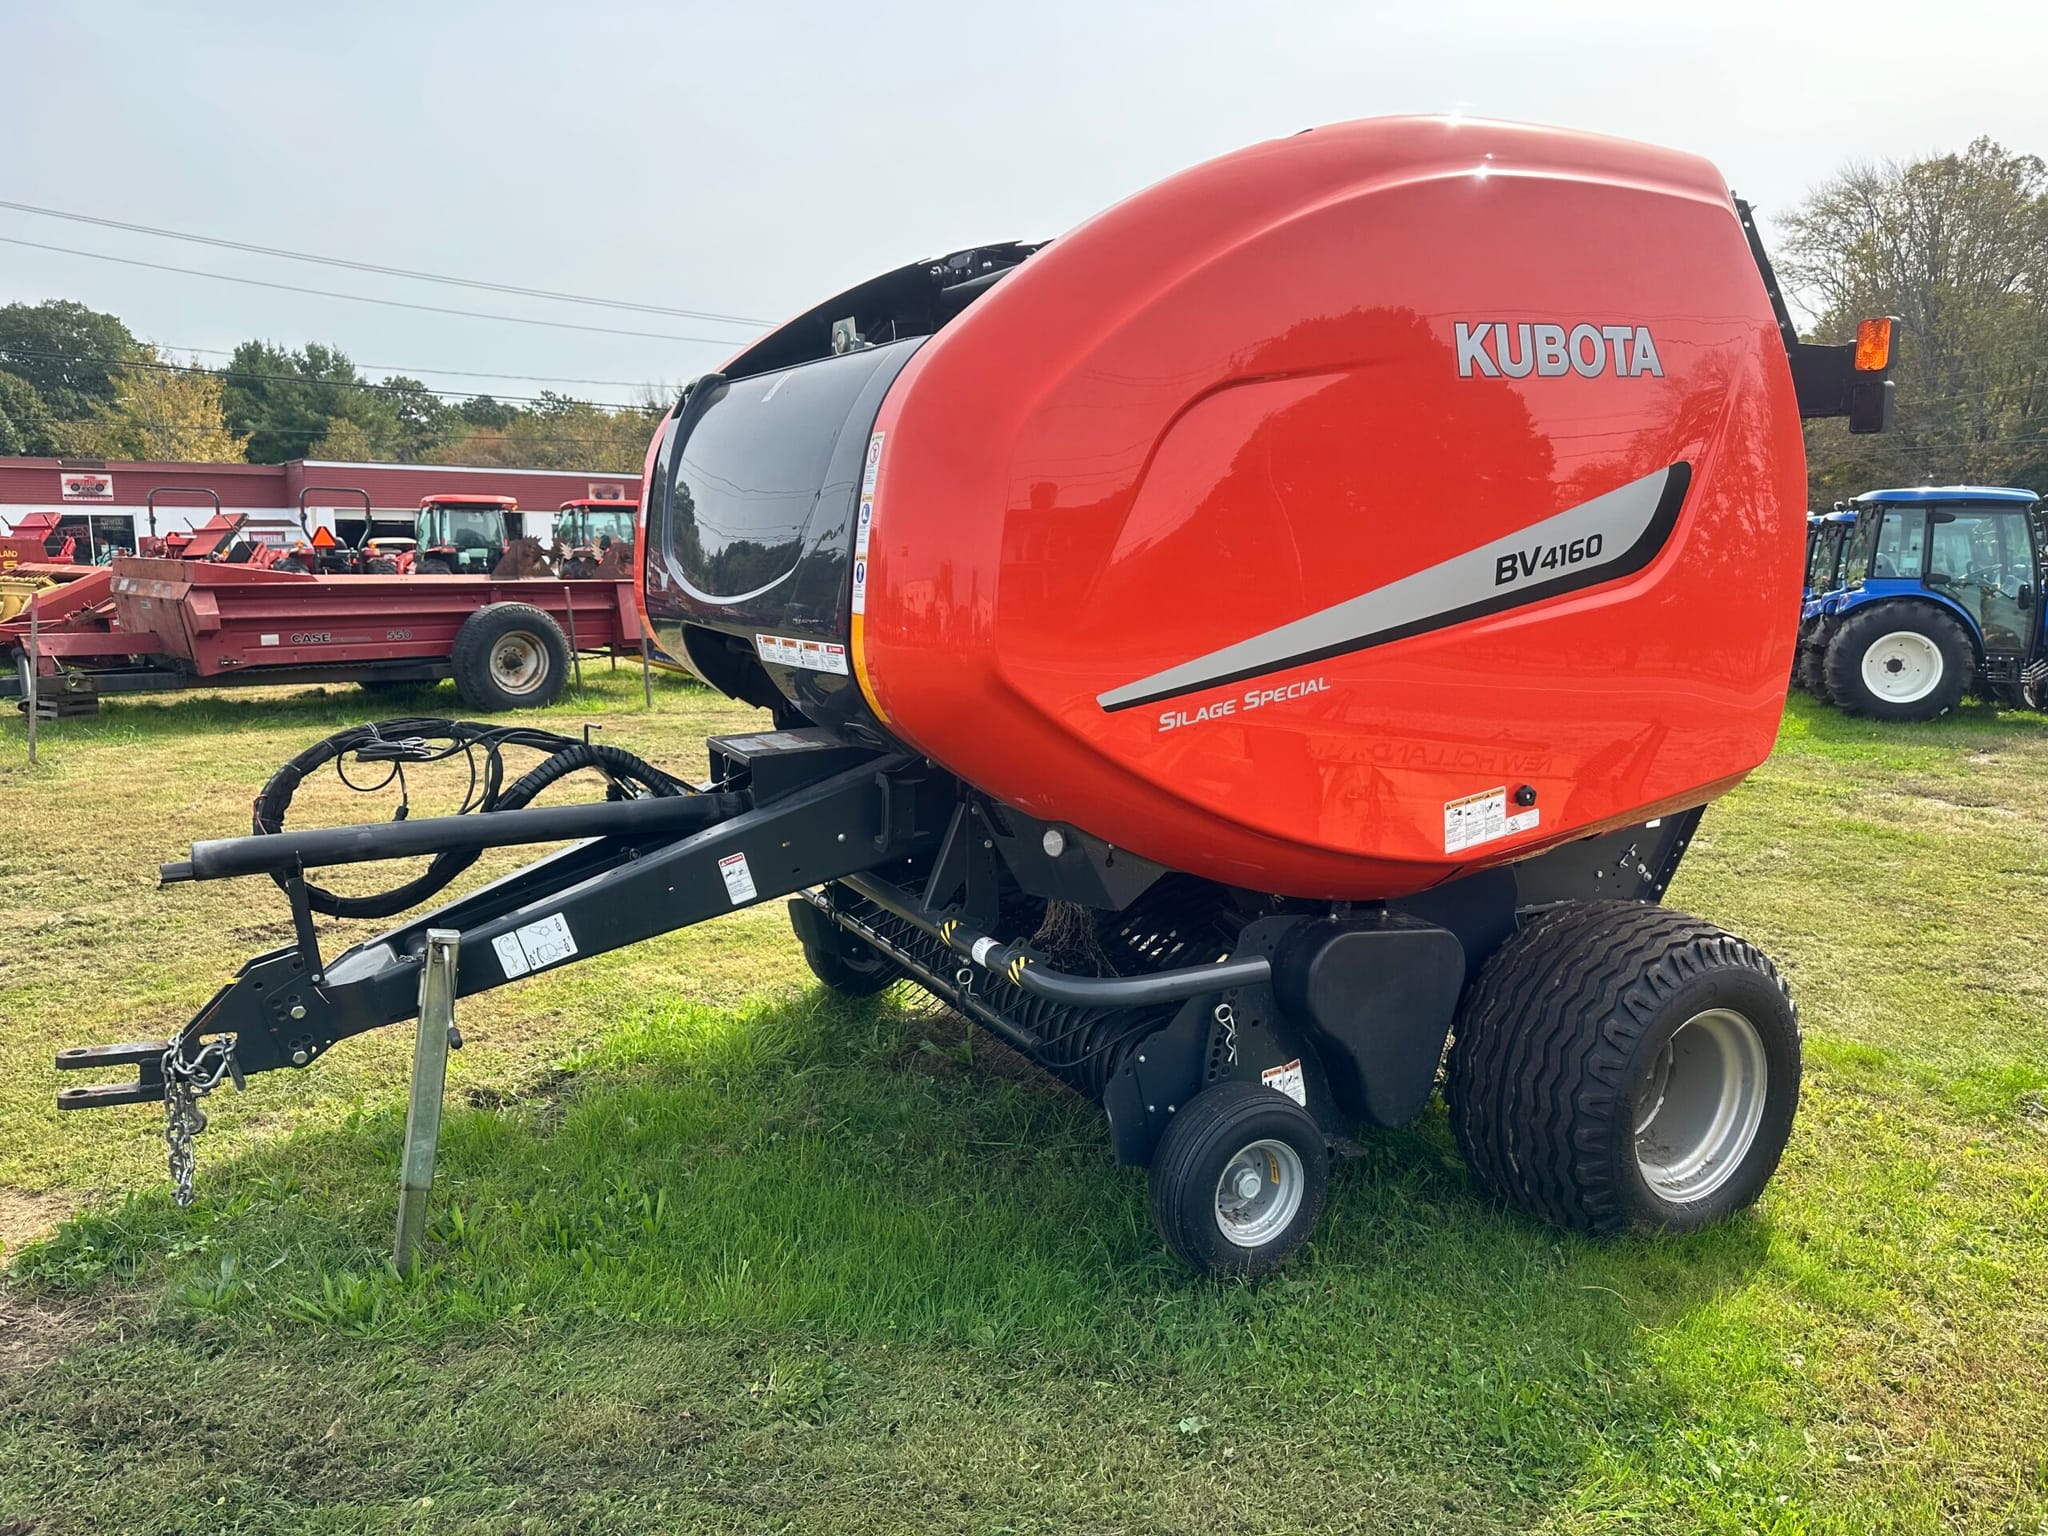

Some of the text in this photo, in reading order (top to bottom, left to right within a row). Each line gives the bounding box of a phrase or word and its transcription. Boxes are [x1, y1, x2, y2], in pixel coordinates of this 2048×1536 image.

[1454, 321, 1665, 378] KUBOTA
[1495, 533, 1602, 586] BV4160
[291, 632, 331, 644] CASE
[387, 630, 412, 640] 550
